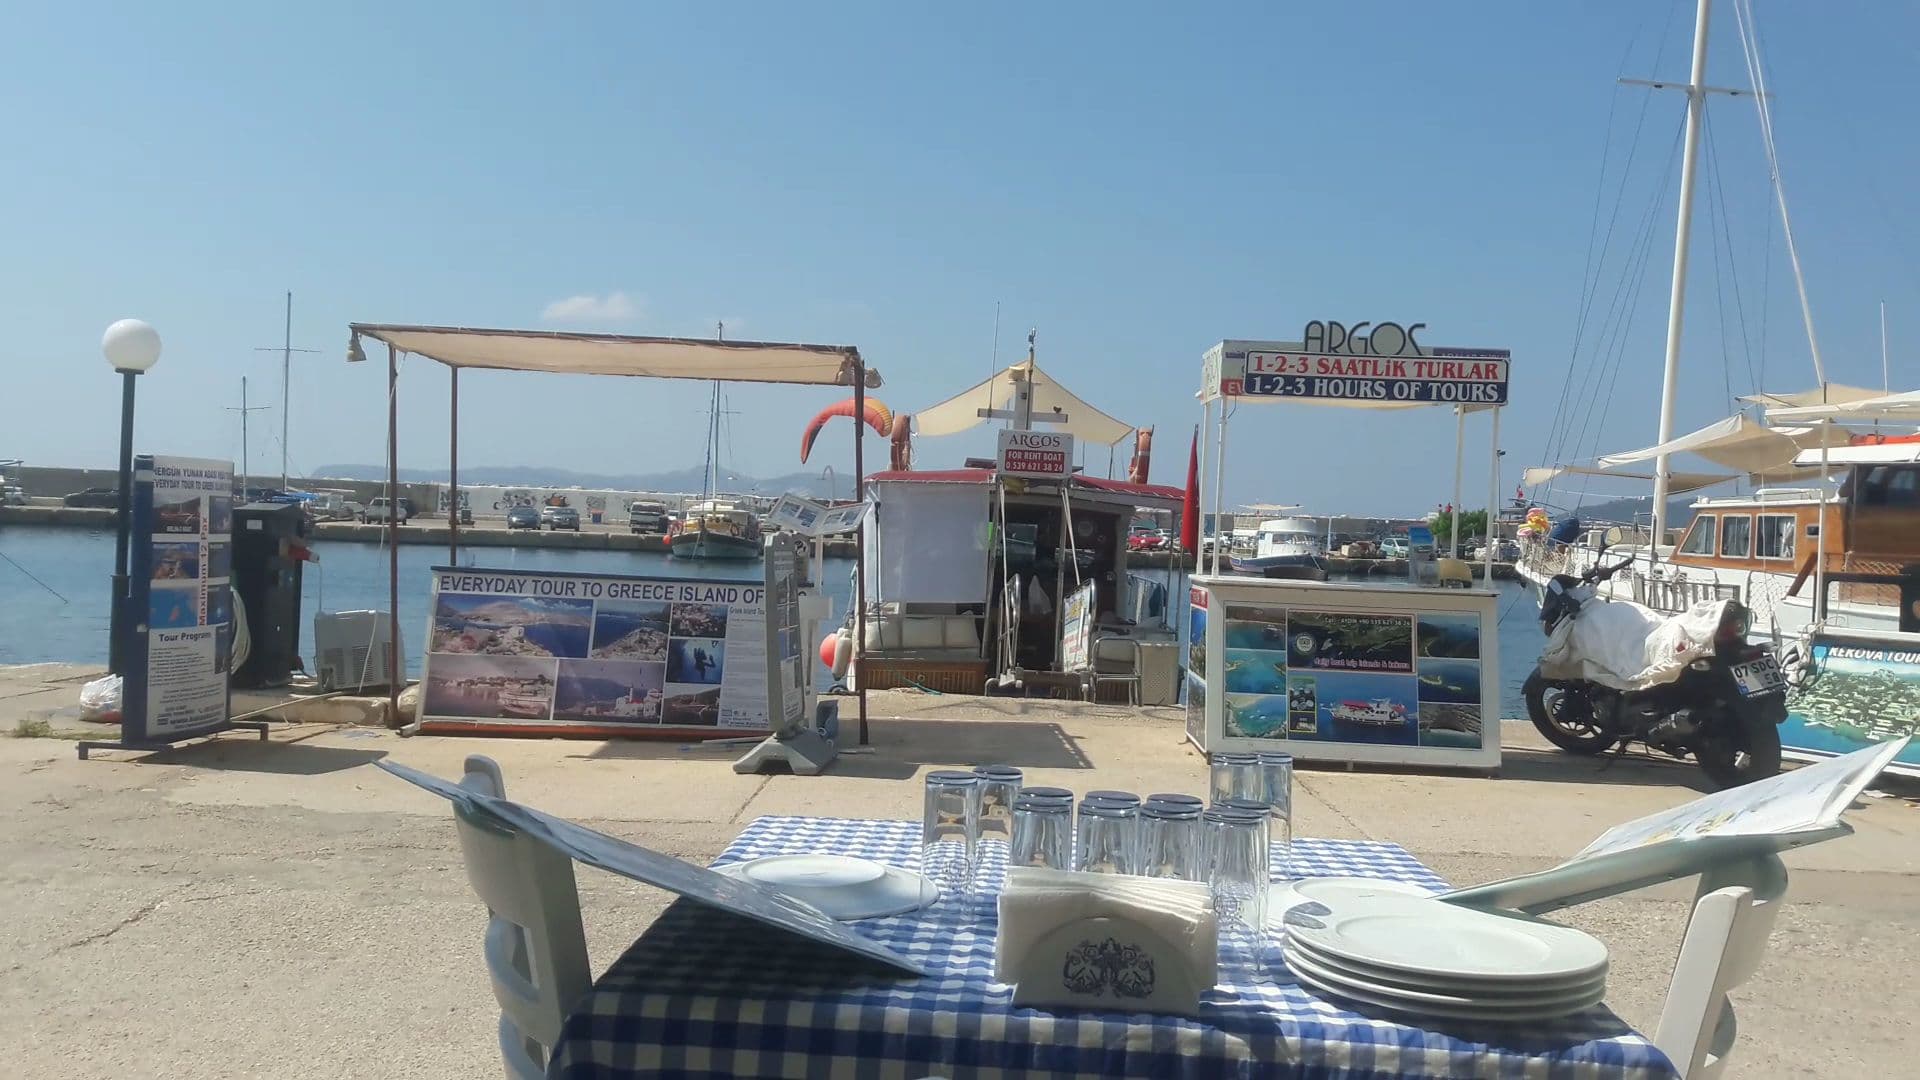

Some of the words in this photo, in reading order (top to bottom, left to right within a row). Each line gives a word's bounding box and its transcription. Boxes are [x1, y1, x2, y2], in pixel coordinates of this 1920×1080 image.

[1304, 320, 1427, 356] ARGOS
[1254, 355, 1309, 374] 1-2-3
[1413, 361, 1498, 380] TURLAR
[1251, 376, 1306, 396] 1-2-3
[1314, 378, 1386, 399] HOURS
[1393, 380, 1422, 400] OF
[1426, 382, 1499, 402] TOURS
[1009, 434, 1061, 448] ARGOS
[1008, 451, 1022, 459] FOR
[1024, 452, 1041, 460] RENT
[1043, 453, 1062, 461] BOAT
[1054, 463, 1063, 472] 24
[200, 517, 208, 541] Pax
[200, 543, 208, 558] 12
[199, 564, 208, 626] Maximum
[440, 576, 527, 595] EVERYDAY
[531, 578, 578, 597] TOUR
[582, 581, 604, 598] TO
[607, 581, 673, 601] GREECE
[678, 584, 738, 603] ISLAND
[742, 586, 764, 605] OF
[159, 633, 178, 643] Tour
[1828, 646, 1884, 661] KEKOVA
[1734, 665, 1748, 678] 07
[1750, 658, 1775, 673] SDC
